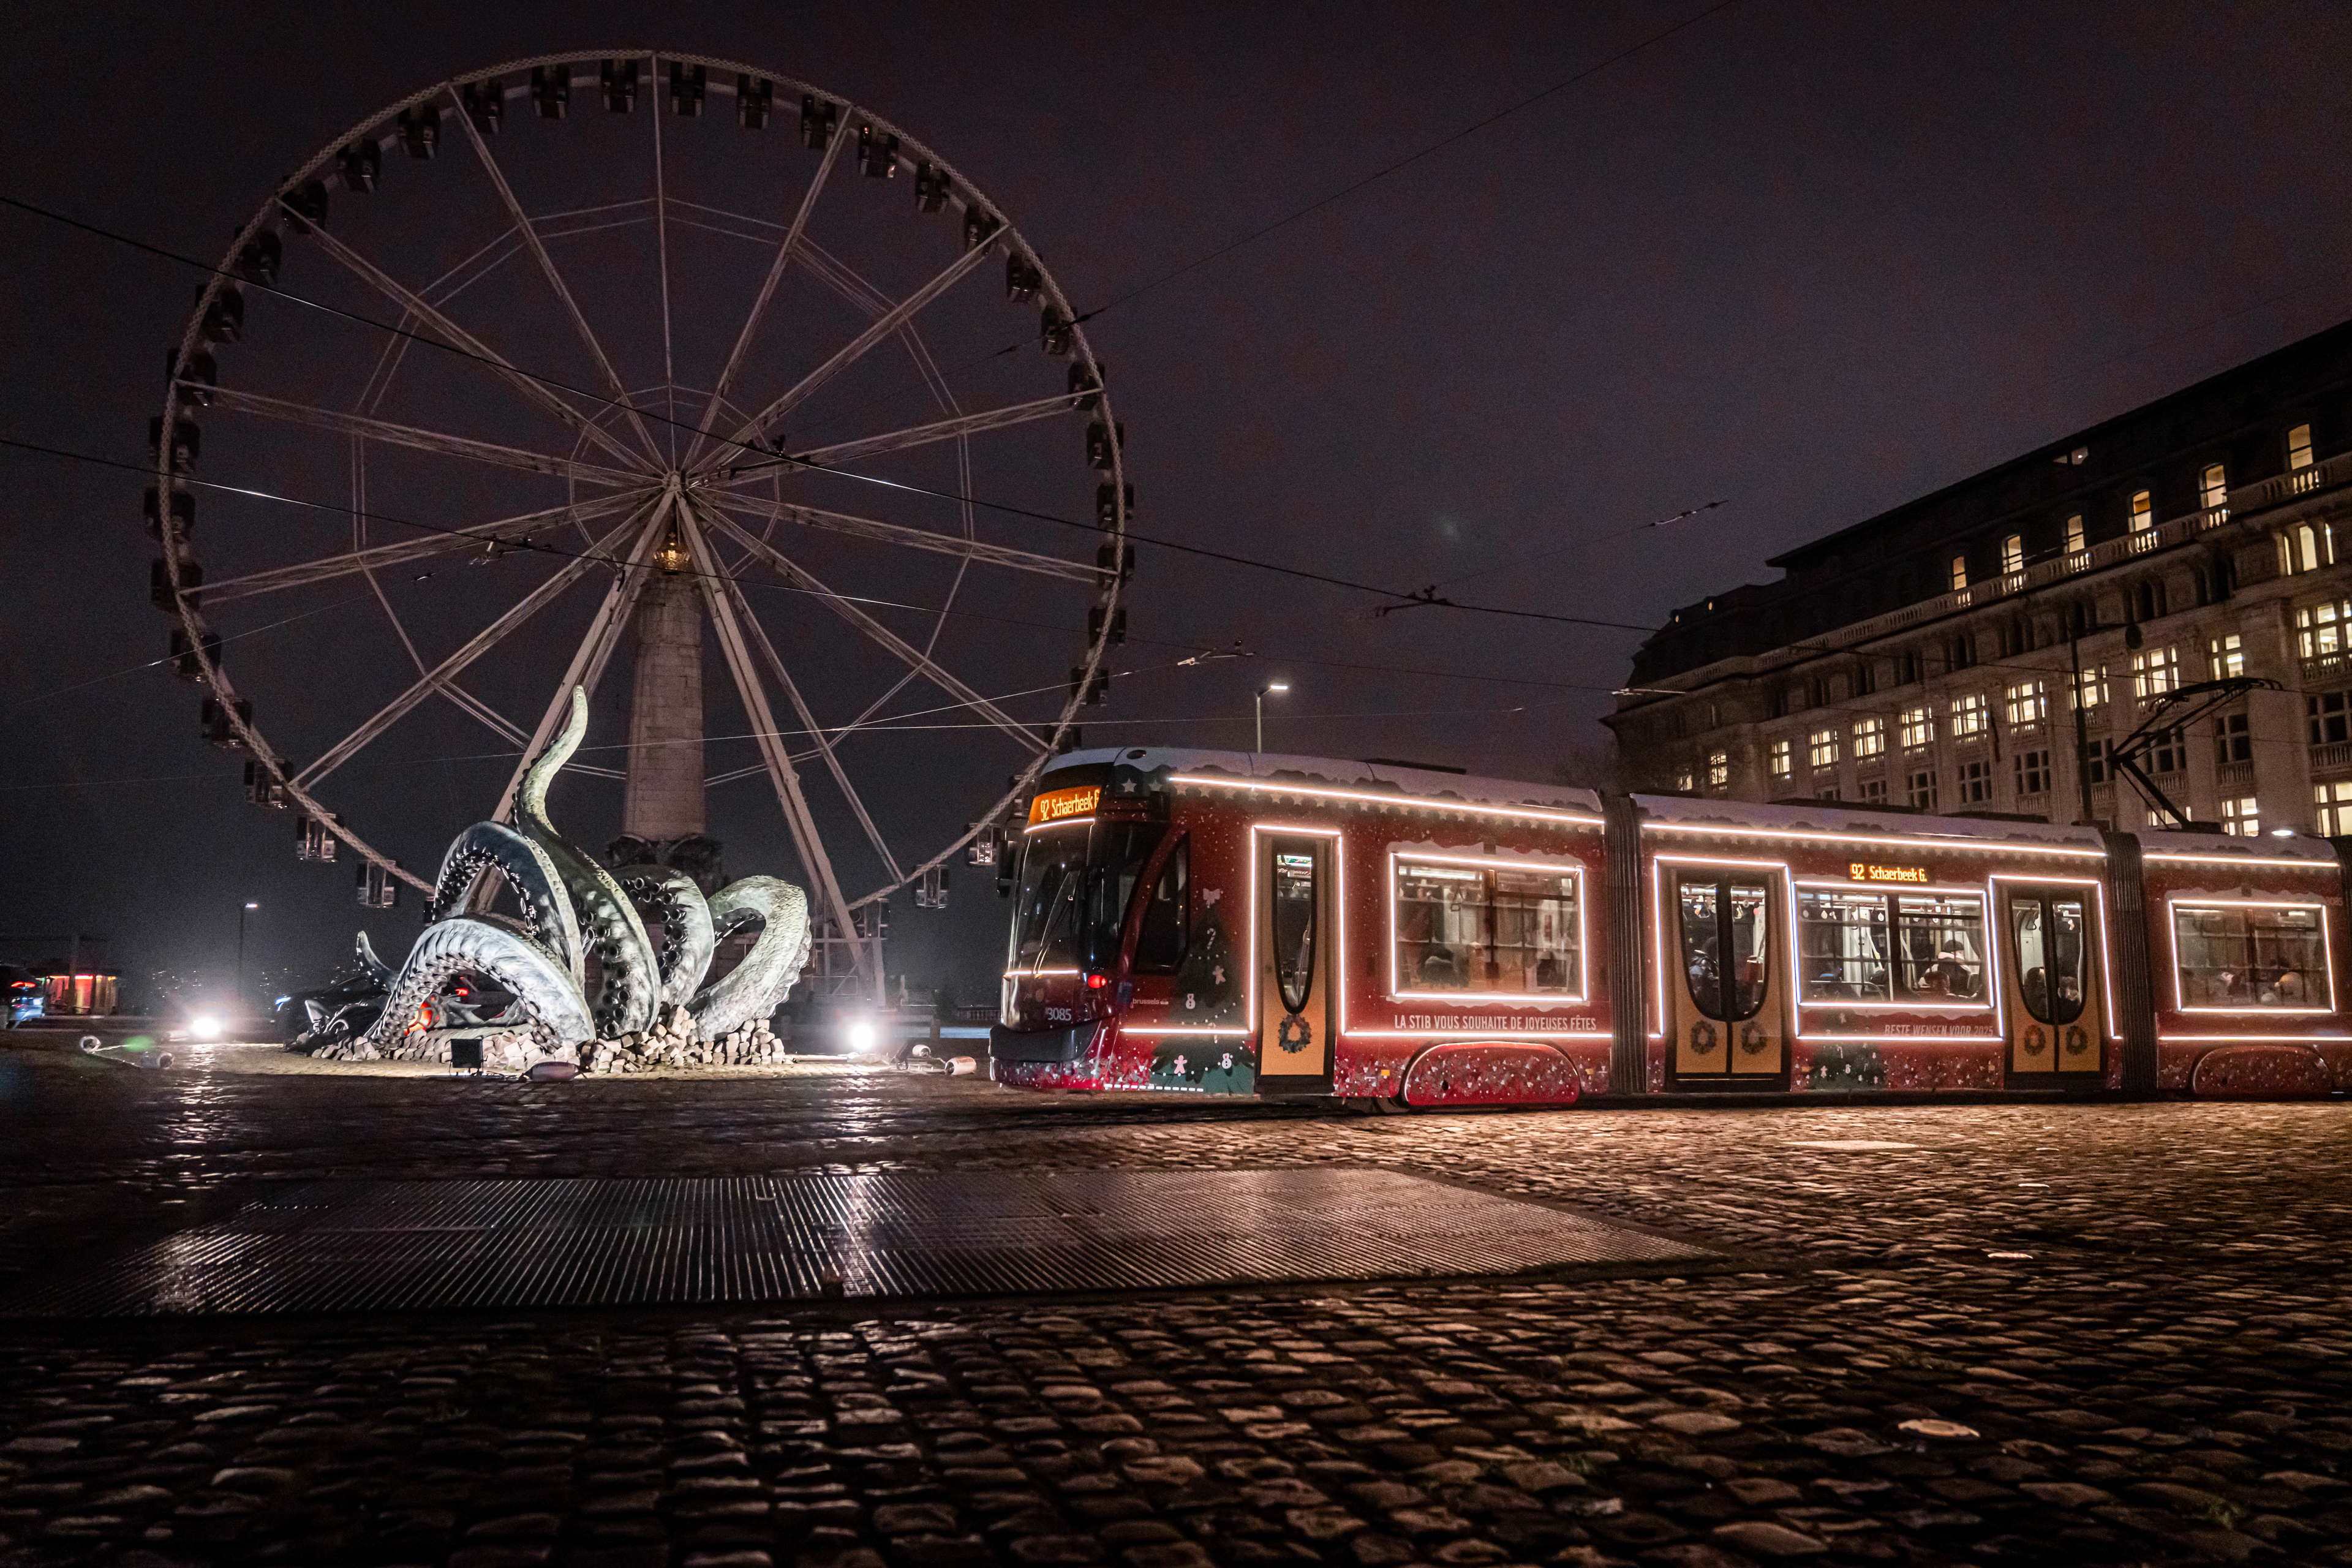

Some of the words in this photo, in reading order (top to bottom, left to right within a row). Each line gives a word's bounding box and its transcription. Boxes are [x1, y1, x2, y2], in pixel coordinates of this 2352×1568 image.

[1041, 799, 1049, 821] 92
[1052, 791, 1093, 817] Schaerbeek
[1850, 863, 1865, 880] 92
[1869, 865, 1917, 881] Schaerbeek
[1394, 1014, 1406, 1029] LA
[1409, 1015, 1431, 1029] STIB
[1434, 1015, 1460, 1030] VOUS
[1463, 1016, 1507, 1030] SOUHAITE
[1510, 1016, 1522, 1030] DE
[1525, 1016, 1567, 1031] JOYEUSES
[1570, 1014, 1597, 1031] FÊTES
[1885, 1024, 1910, 1035] BESTE
[1913, 1025, 1947, 1036] WENSEN
[1950, 1025, 1971, 1036] VOOR
[1974, 1026, 1994, 1036] 2025
